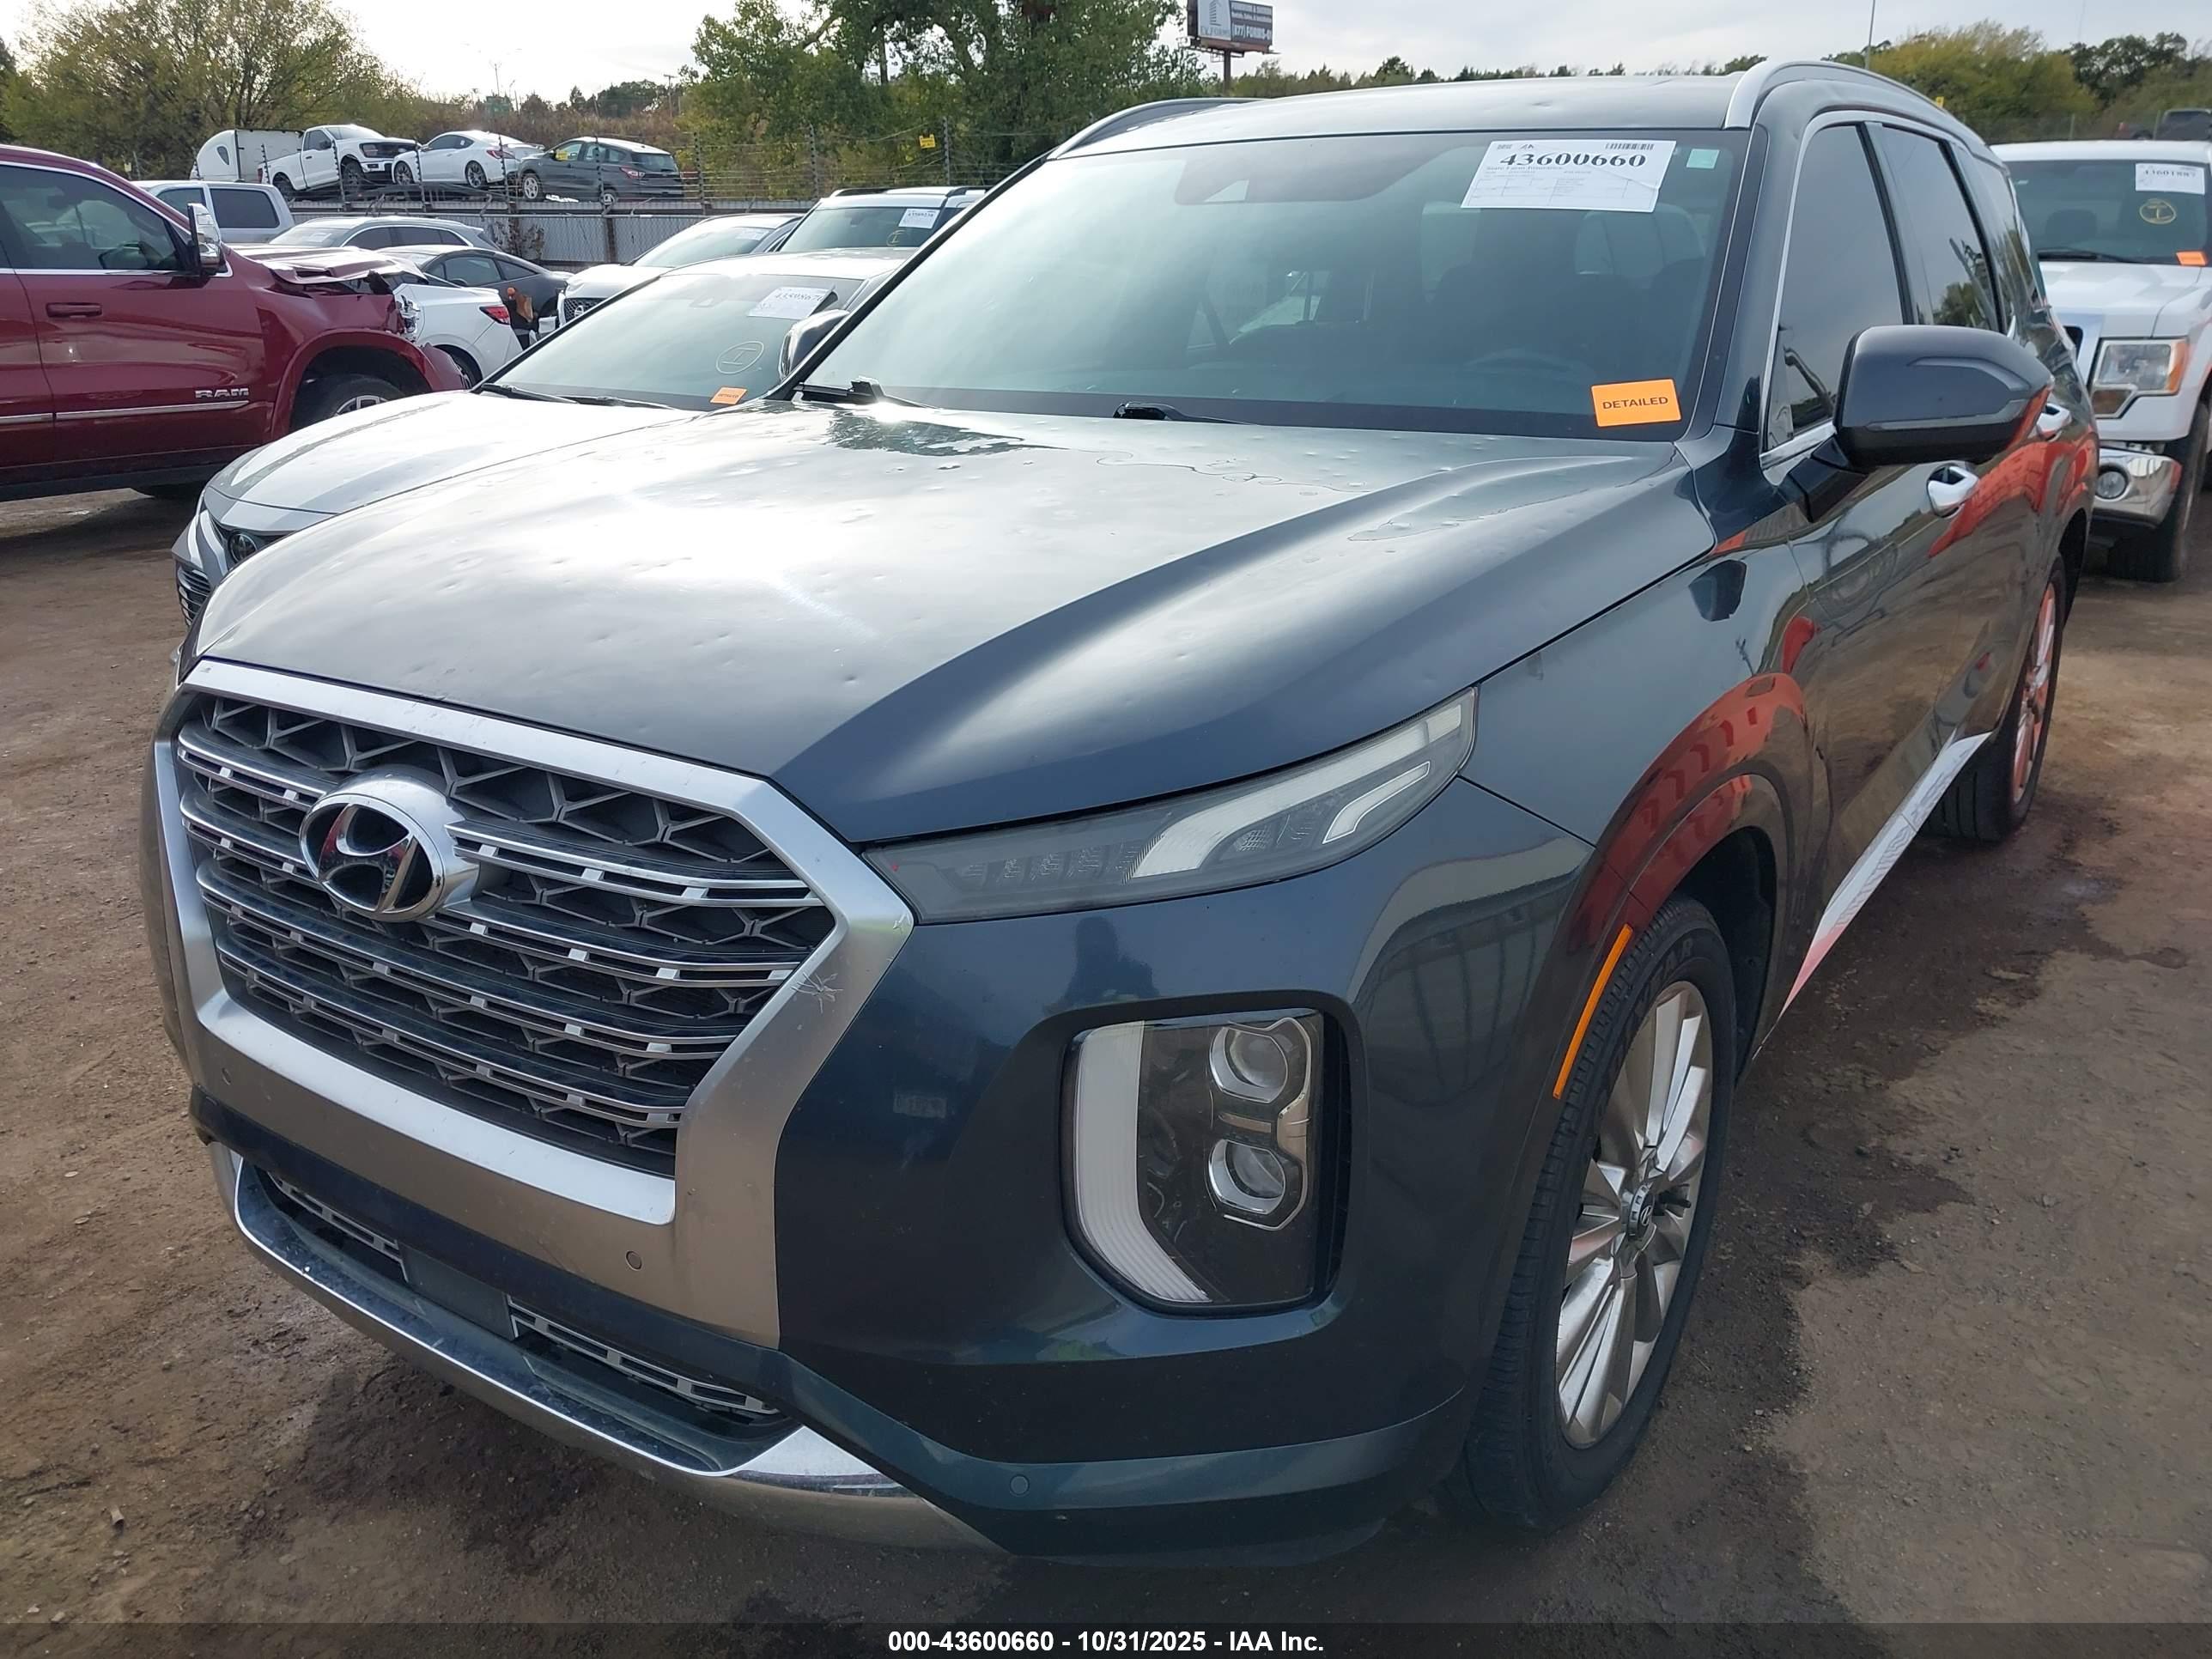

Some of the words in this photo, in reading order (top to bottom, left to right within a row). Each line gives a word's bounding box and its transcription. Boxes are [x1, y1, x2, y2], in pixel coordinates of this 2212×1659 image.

[1499, 152, 1647, 167] 43600660
[195, 387, 249, 398] RAM
[1602, 396, 1668, 410] DETAILED
